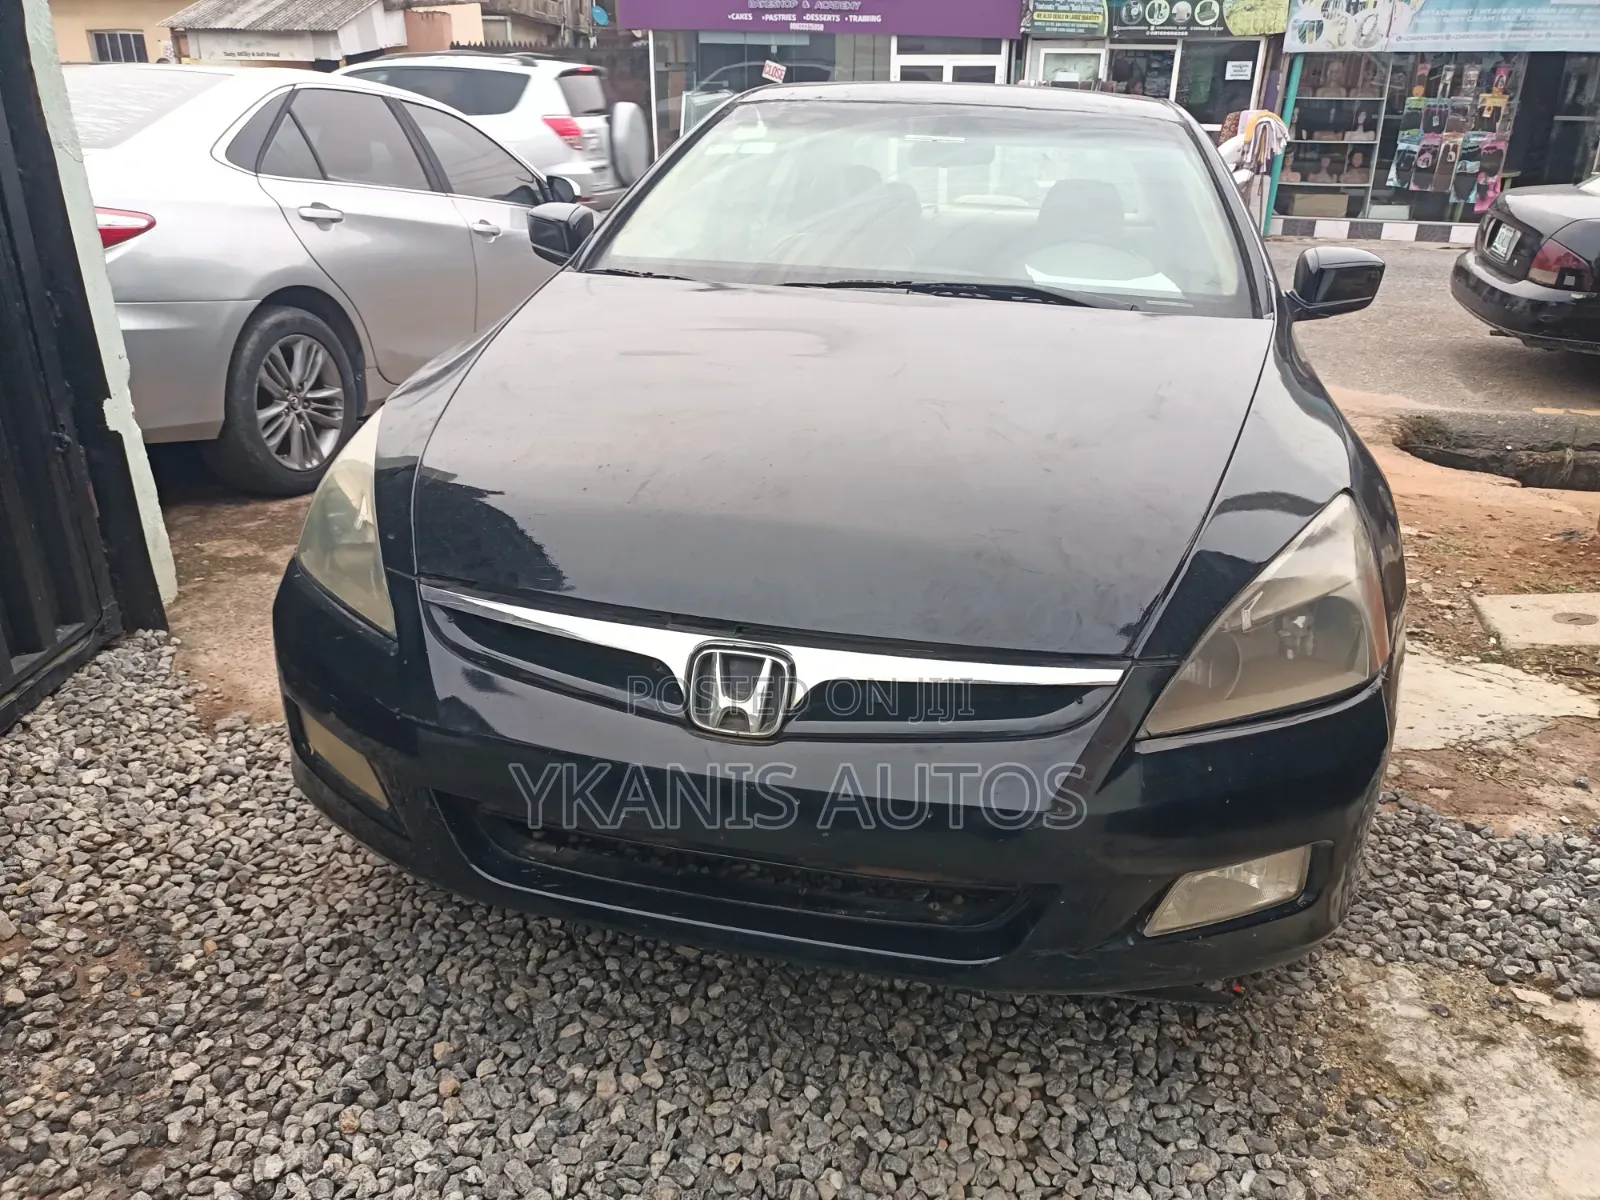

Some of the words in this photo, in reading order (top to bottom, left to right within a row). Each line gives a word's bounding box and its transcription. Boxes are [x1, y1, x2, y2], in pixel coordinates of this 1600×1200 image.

[814, 1, 861, 10] ACADEMY
[731, 13, 753, 21] CAKES
[806, 14, 841, 22] DESSERTS
